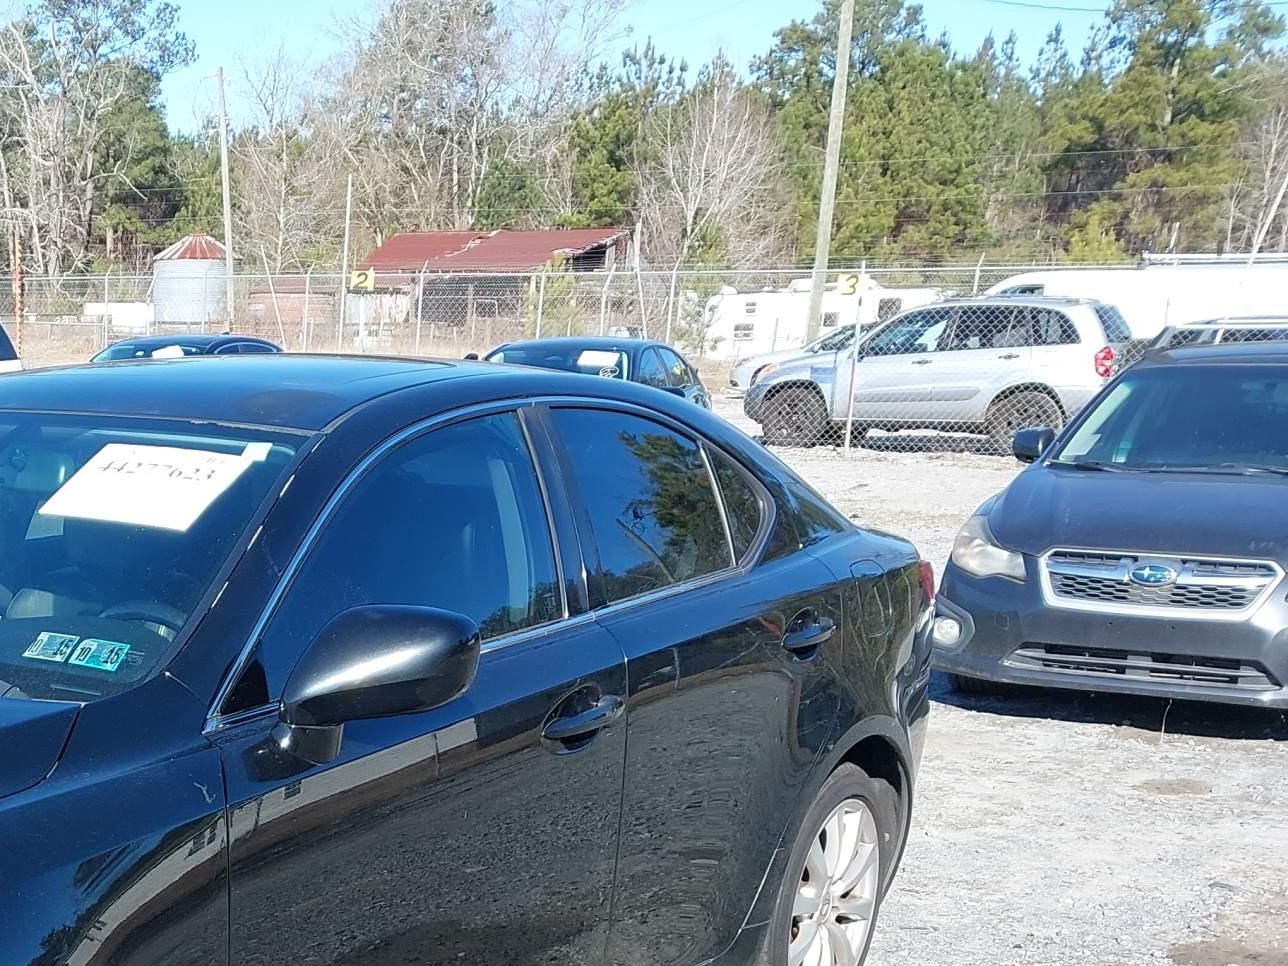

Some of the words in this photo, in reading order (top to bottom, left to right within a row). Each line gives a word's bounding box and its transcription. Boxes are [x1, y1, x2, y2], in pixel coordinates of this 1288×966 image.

[353, 272, 368, 289] 2
[840, 274, 858, 295] 3
[75, 646, 92, 662] 10
